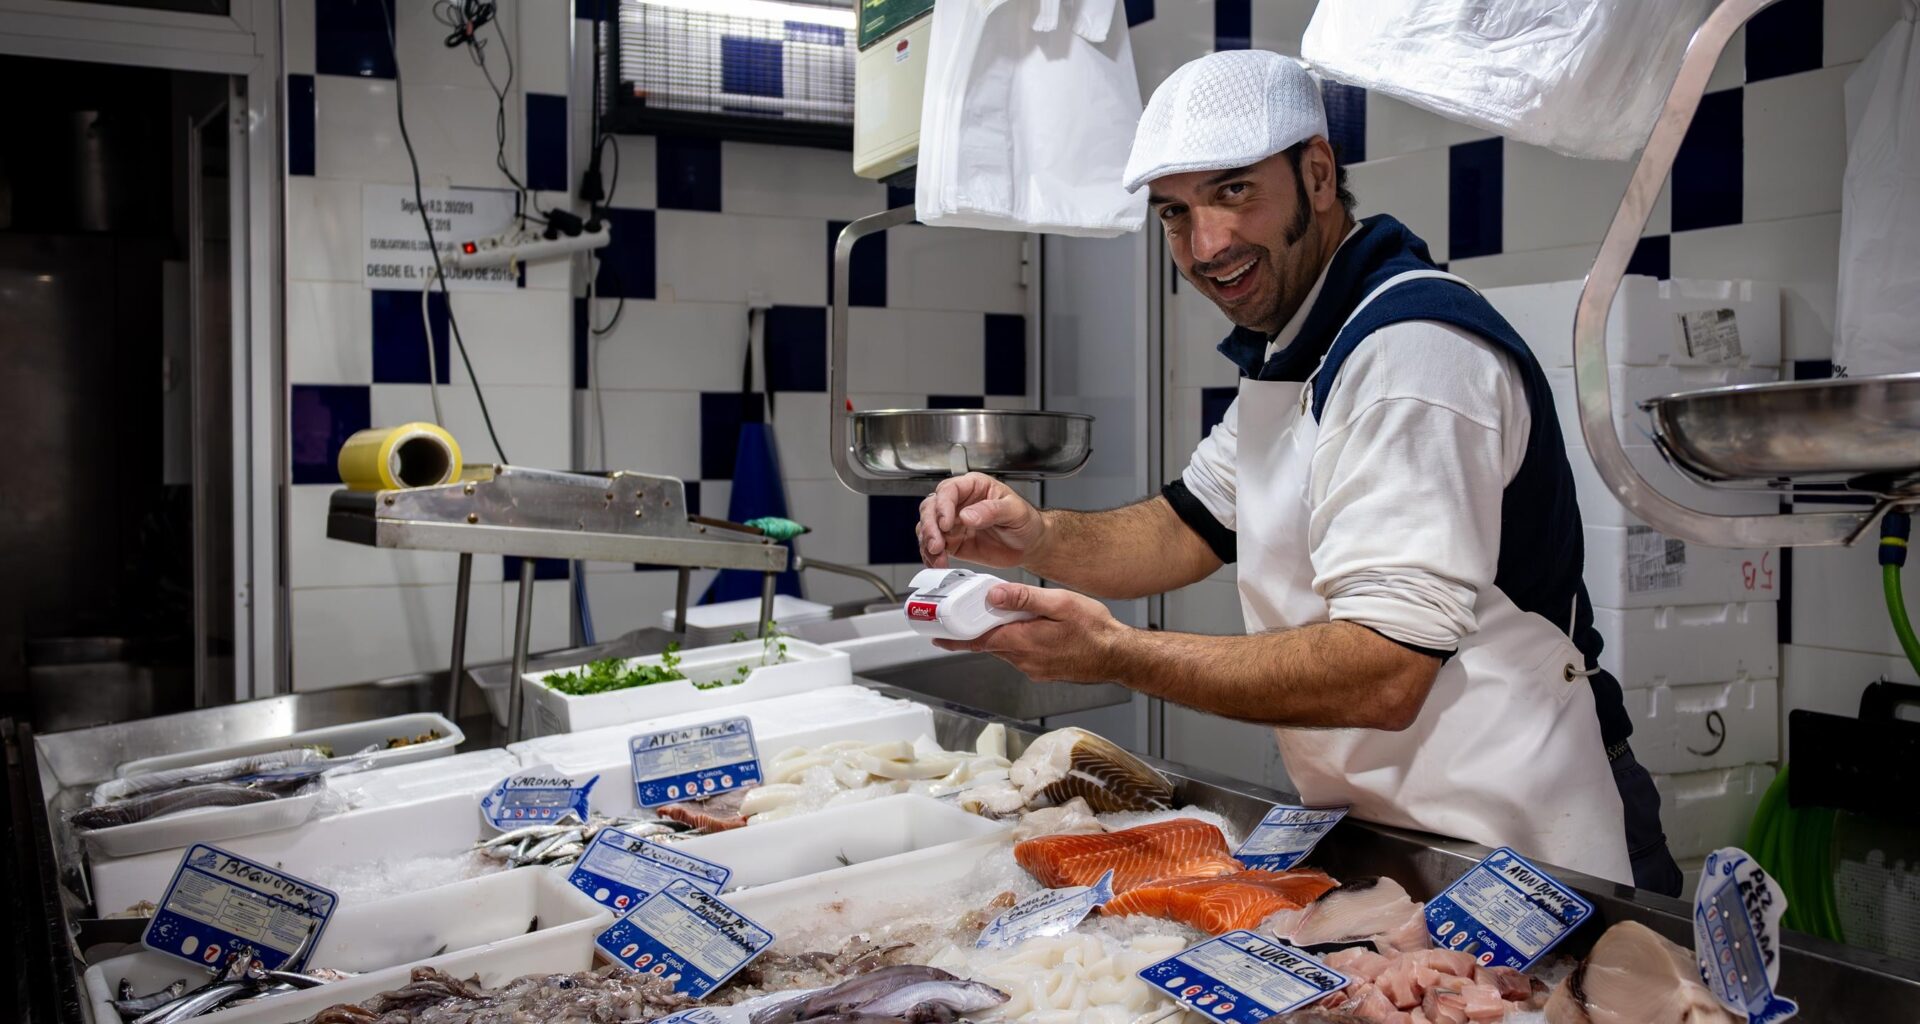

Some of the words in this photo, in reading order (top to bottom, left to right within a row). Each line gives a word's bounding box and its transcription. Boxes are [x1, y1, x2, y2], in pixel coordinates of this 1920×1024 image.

[367, 263, 402, 279] DESDE
[404, 265, 417, 279] EL
[419, 266, 424, 278] 1
[511, 776, 575, 788] SARDINAS
[1505, 865, 1540, 888] ATUN
[1749, 868, 1774, 909] PEZ
[1246, 943, 1295, 969] JUREL
